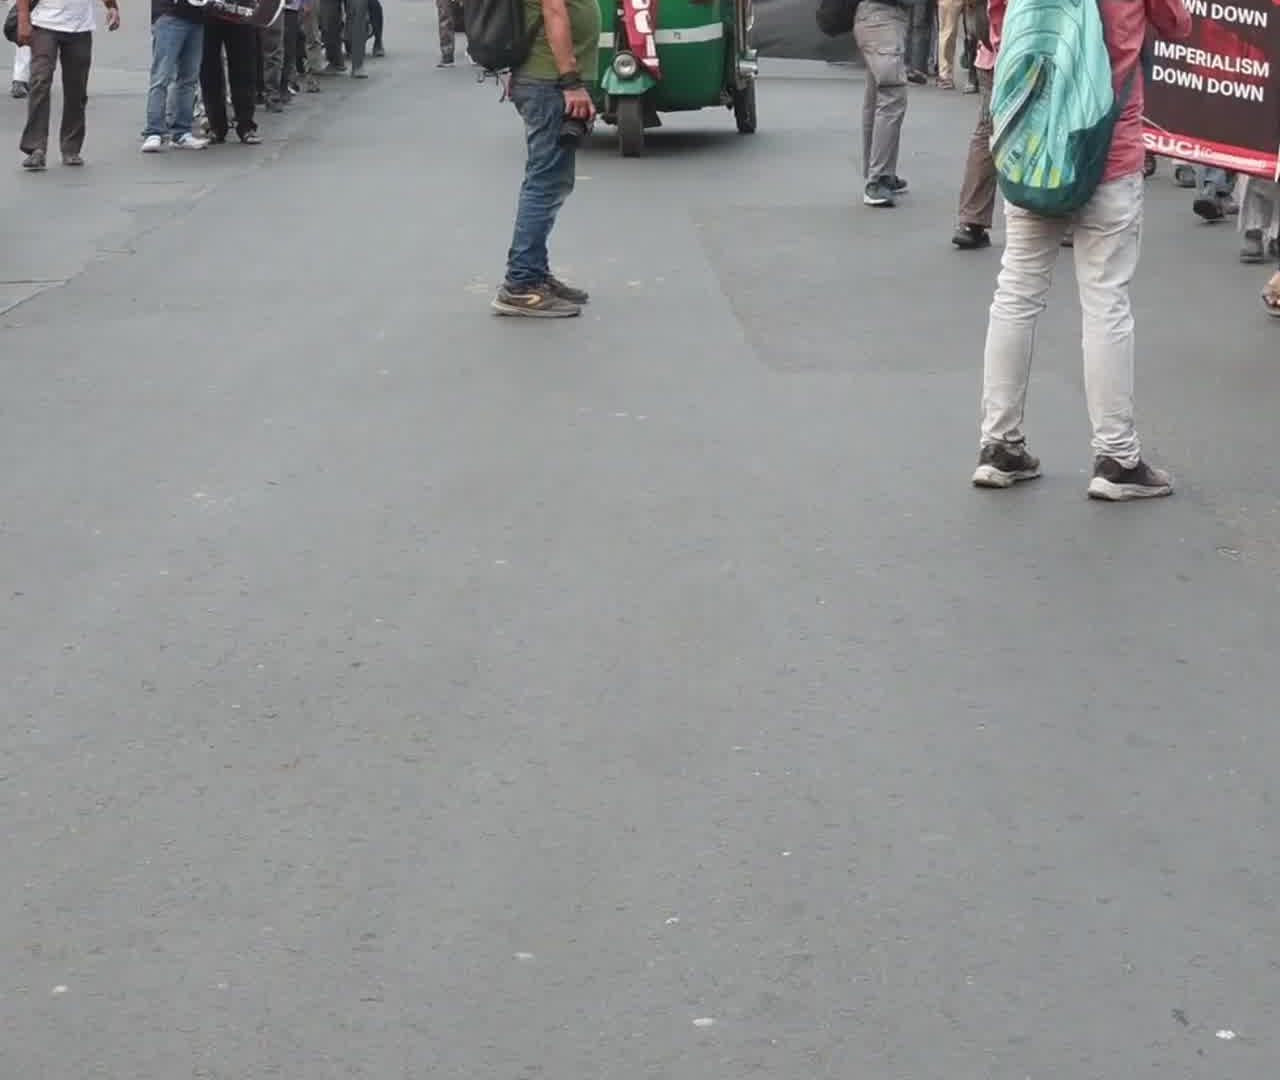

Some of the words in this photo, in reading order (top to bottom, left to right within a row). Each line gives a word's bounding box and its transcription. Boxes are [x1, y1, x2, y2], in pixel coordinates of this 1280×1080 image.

[1211, 3, 1268, 28] DOWN
[1153, 40, 1270, 78] IMPERIALISM
[1152, 65, 1203, 93] DOWN
[1207, 78, 1265, 102] DOWN
[1142, 132, 1201, 158] SUCI
